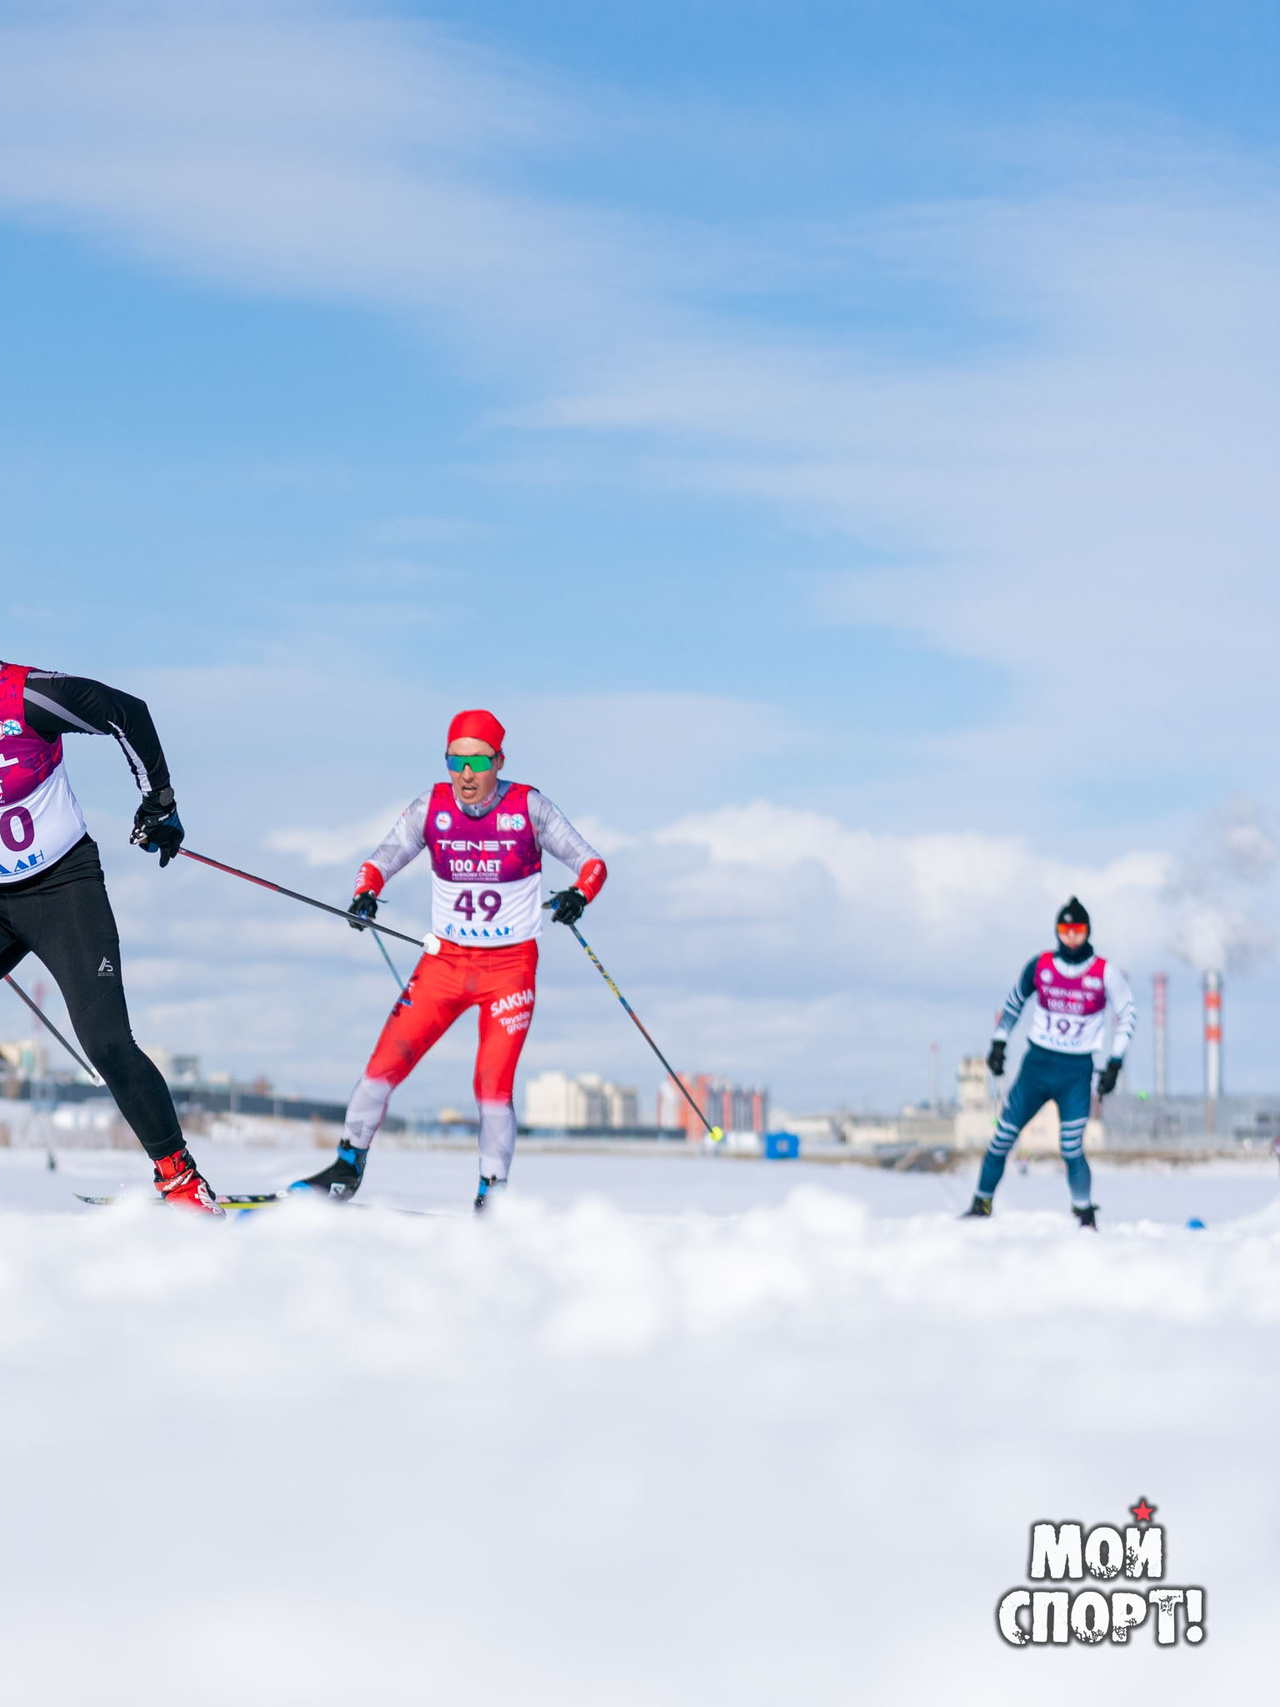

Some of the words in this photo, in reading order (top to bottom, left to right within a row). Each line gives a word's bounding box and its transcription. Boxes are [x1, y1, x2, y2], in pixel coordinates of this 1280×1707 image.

[437, 840, 517, 851] TENET
[449, 859, 473, 872] 100
[476, 859, 501, 872] ЛЕТ
[453, 889, 502, 922] 49
[490, 988, 534, 1018] SAKHA
